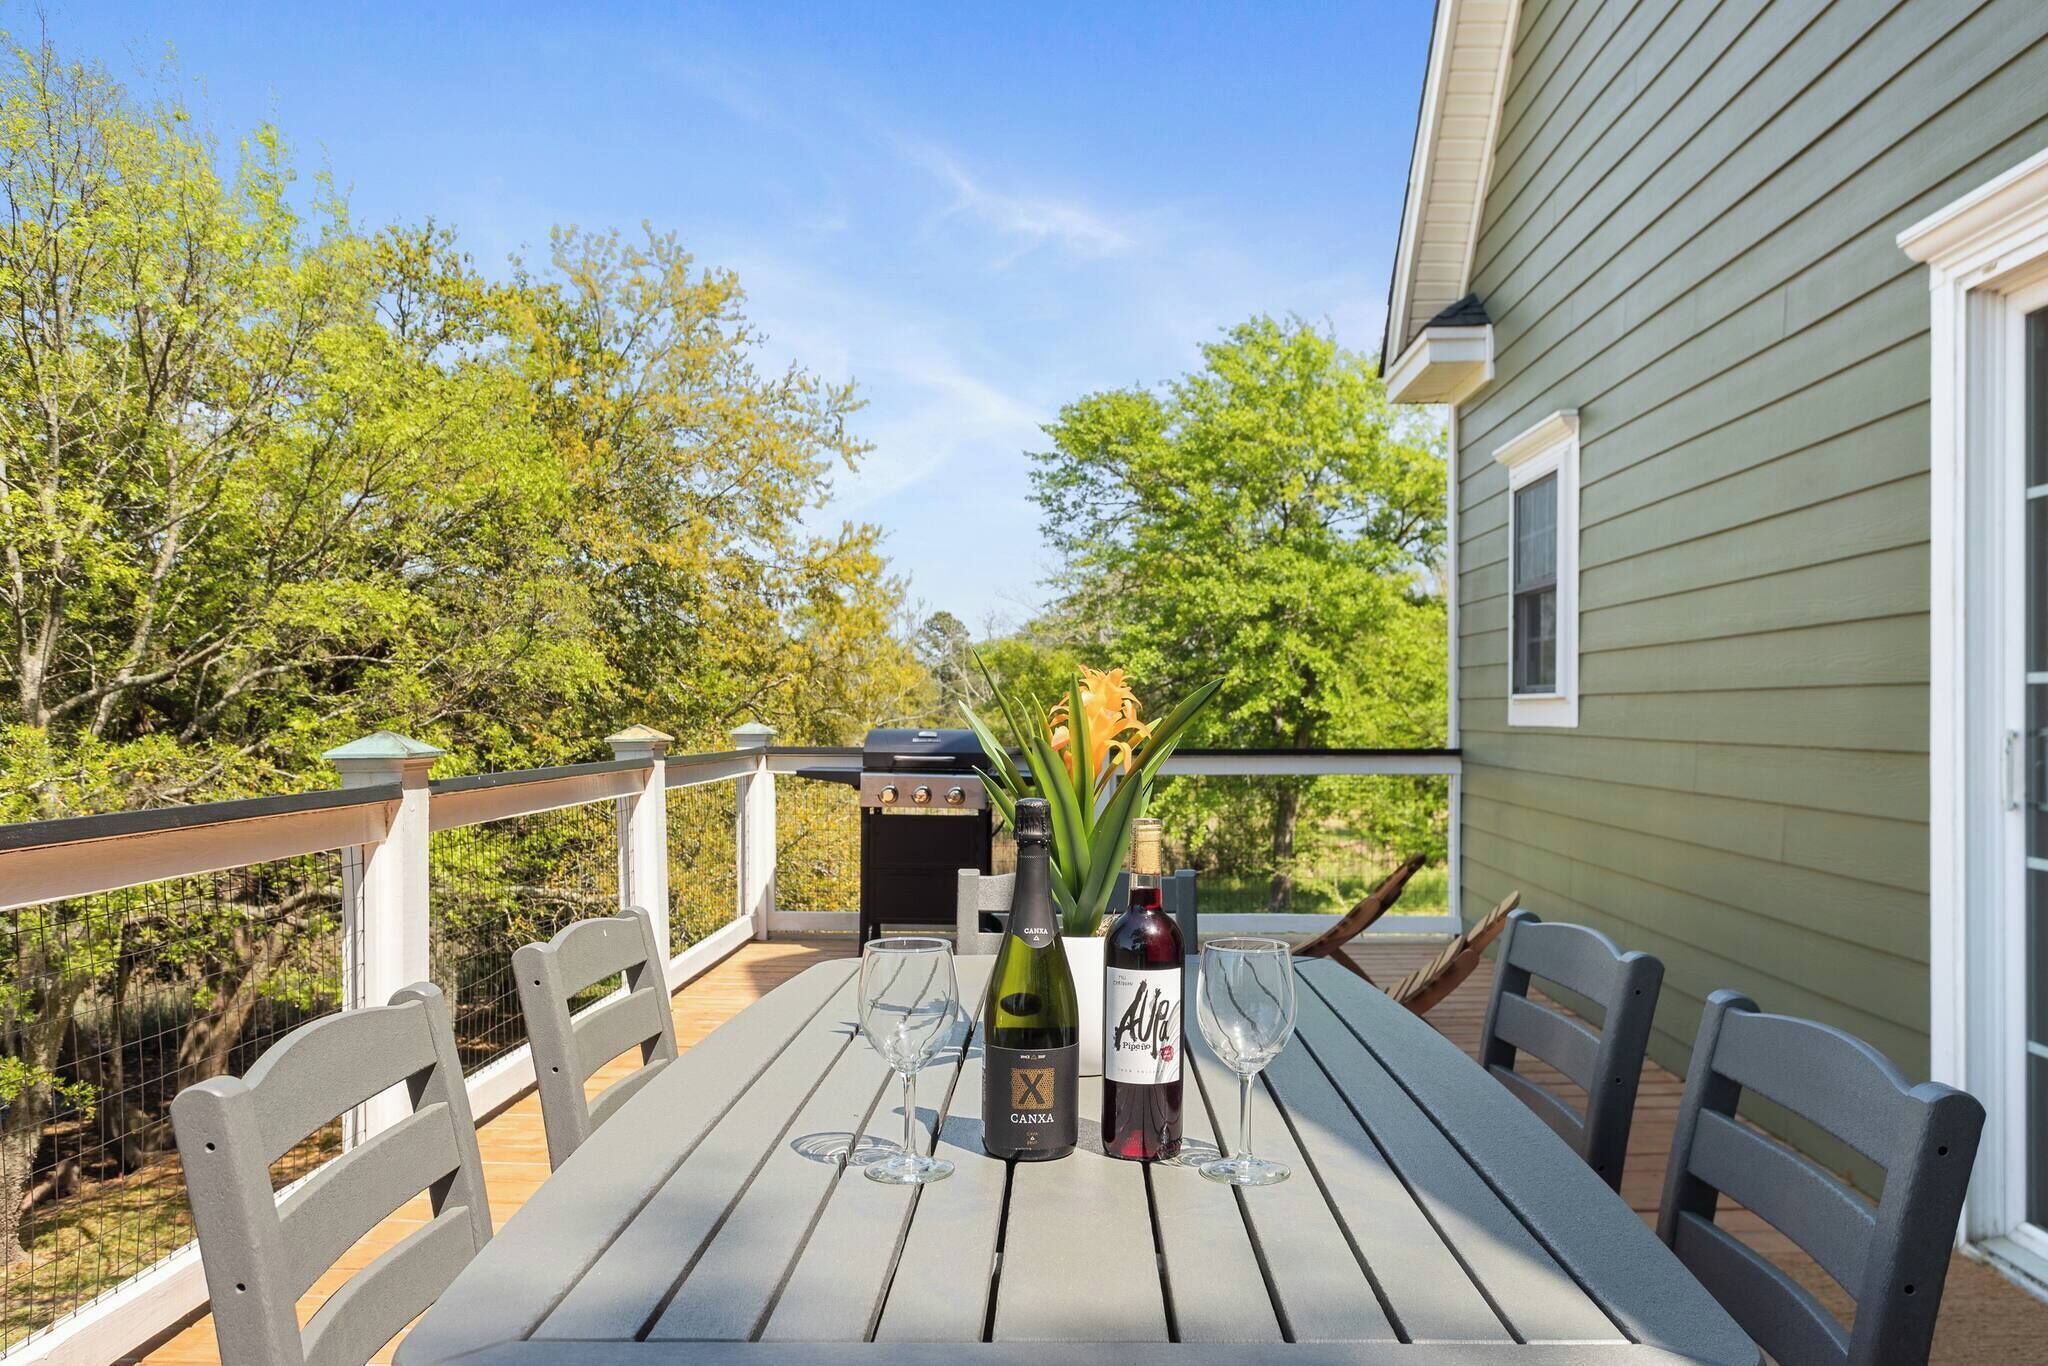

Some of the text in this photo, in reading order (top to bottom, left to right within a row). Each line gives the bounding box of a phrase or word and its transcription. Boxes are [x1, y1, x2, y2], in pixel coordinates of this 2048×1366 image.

[1023, 927, 1049, 936] CANXA
[1018, 1072, 1047, 1105] X
[1010, 1113, 1055, 1125] CANXA
